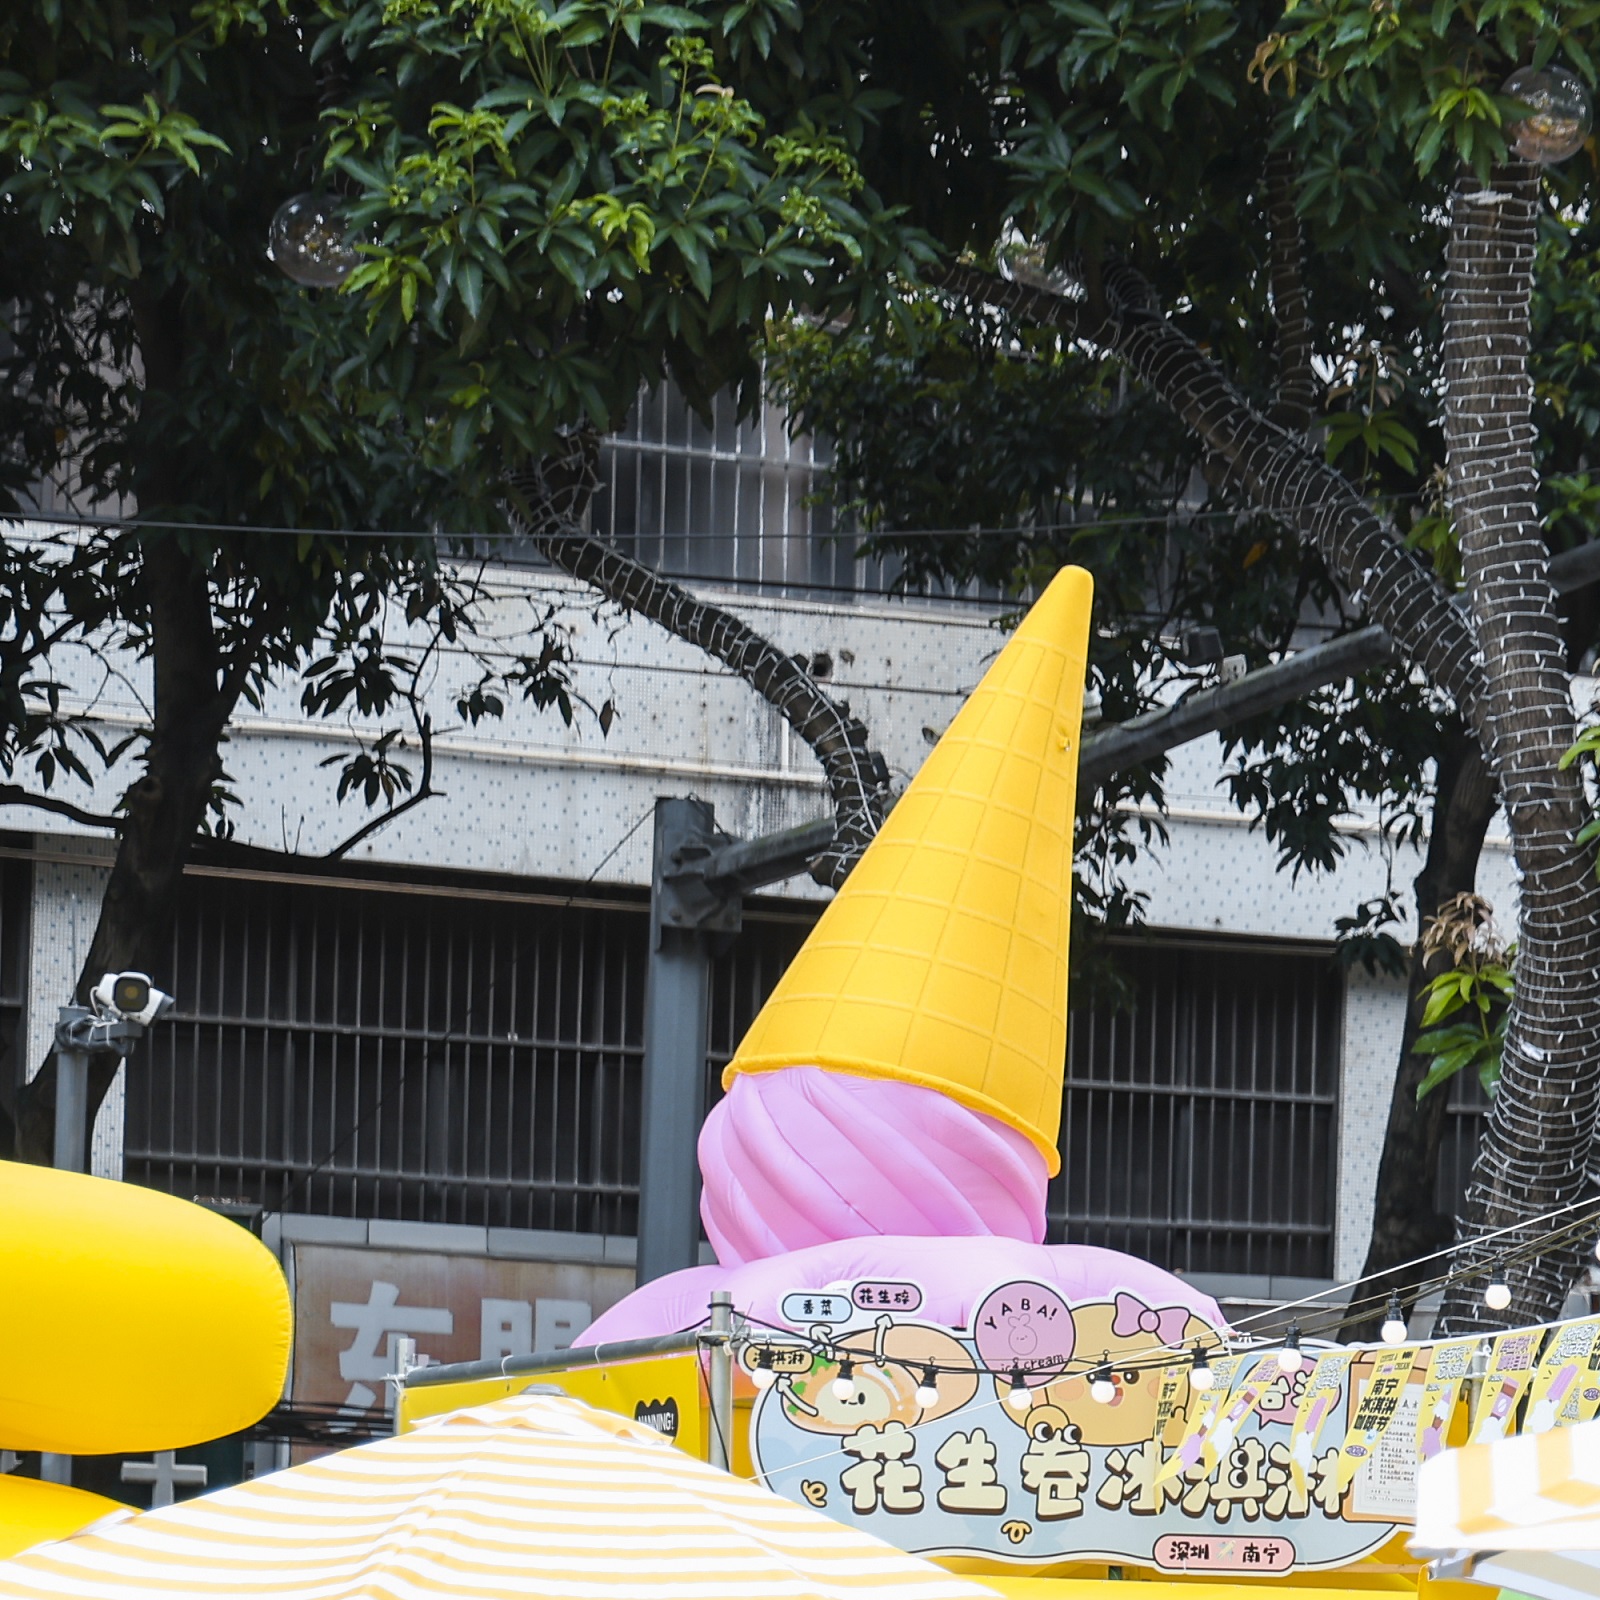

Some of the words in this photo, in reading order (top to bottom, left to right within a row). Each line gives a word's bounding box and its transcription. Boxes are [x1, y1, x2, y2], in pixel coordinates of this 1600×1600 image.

[984, 1298, 1058, 1331] YABA!
[1023, 1354, 1064, 1370] cream
[1371, 1377, 1400, 1396] 南宁
[1359, 1397, 1399, 1415] 冰淇淋
[841, 1420, 1353, 1524] 花生卷冰淇淋
[1168, 1541, 1210, 1563] 深圳
[1242, 1543, 1281, 1565] 南宁
